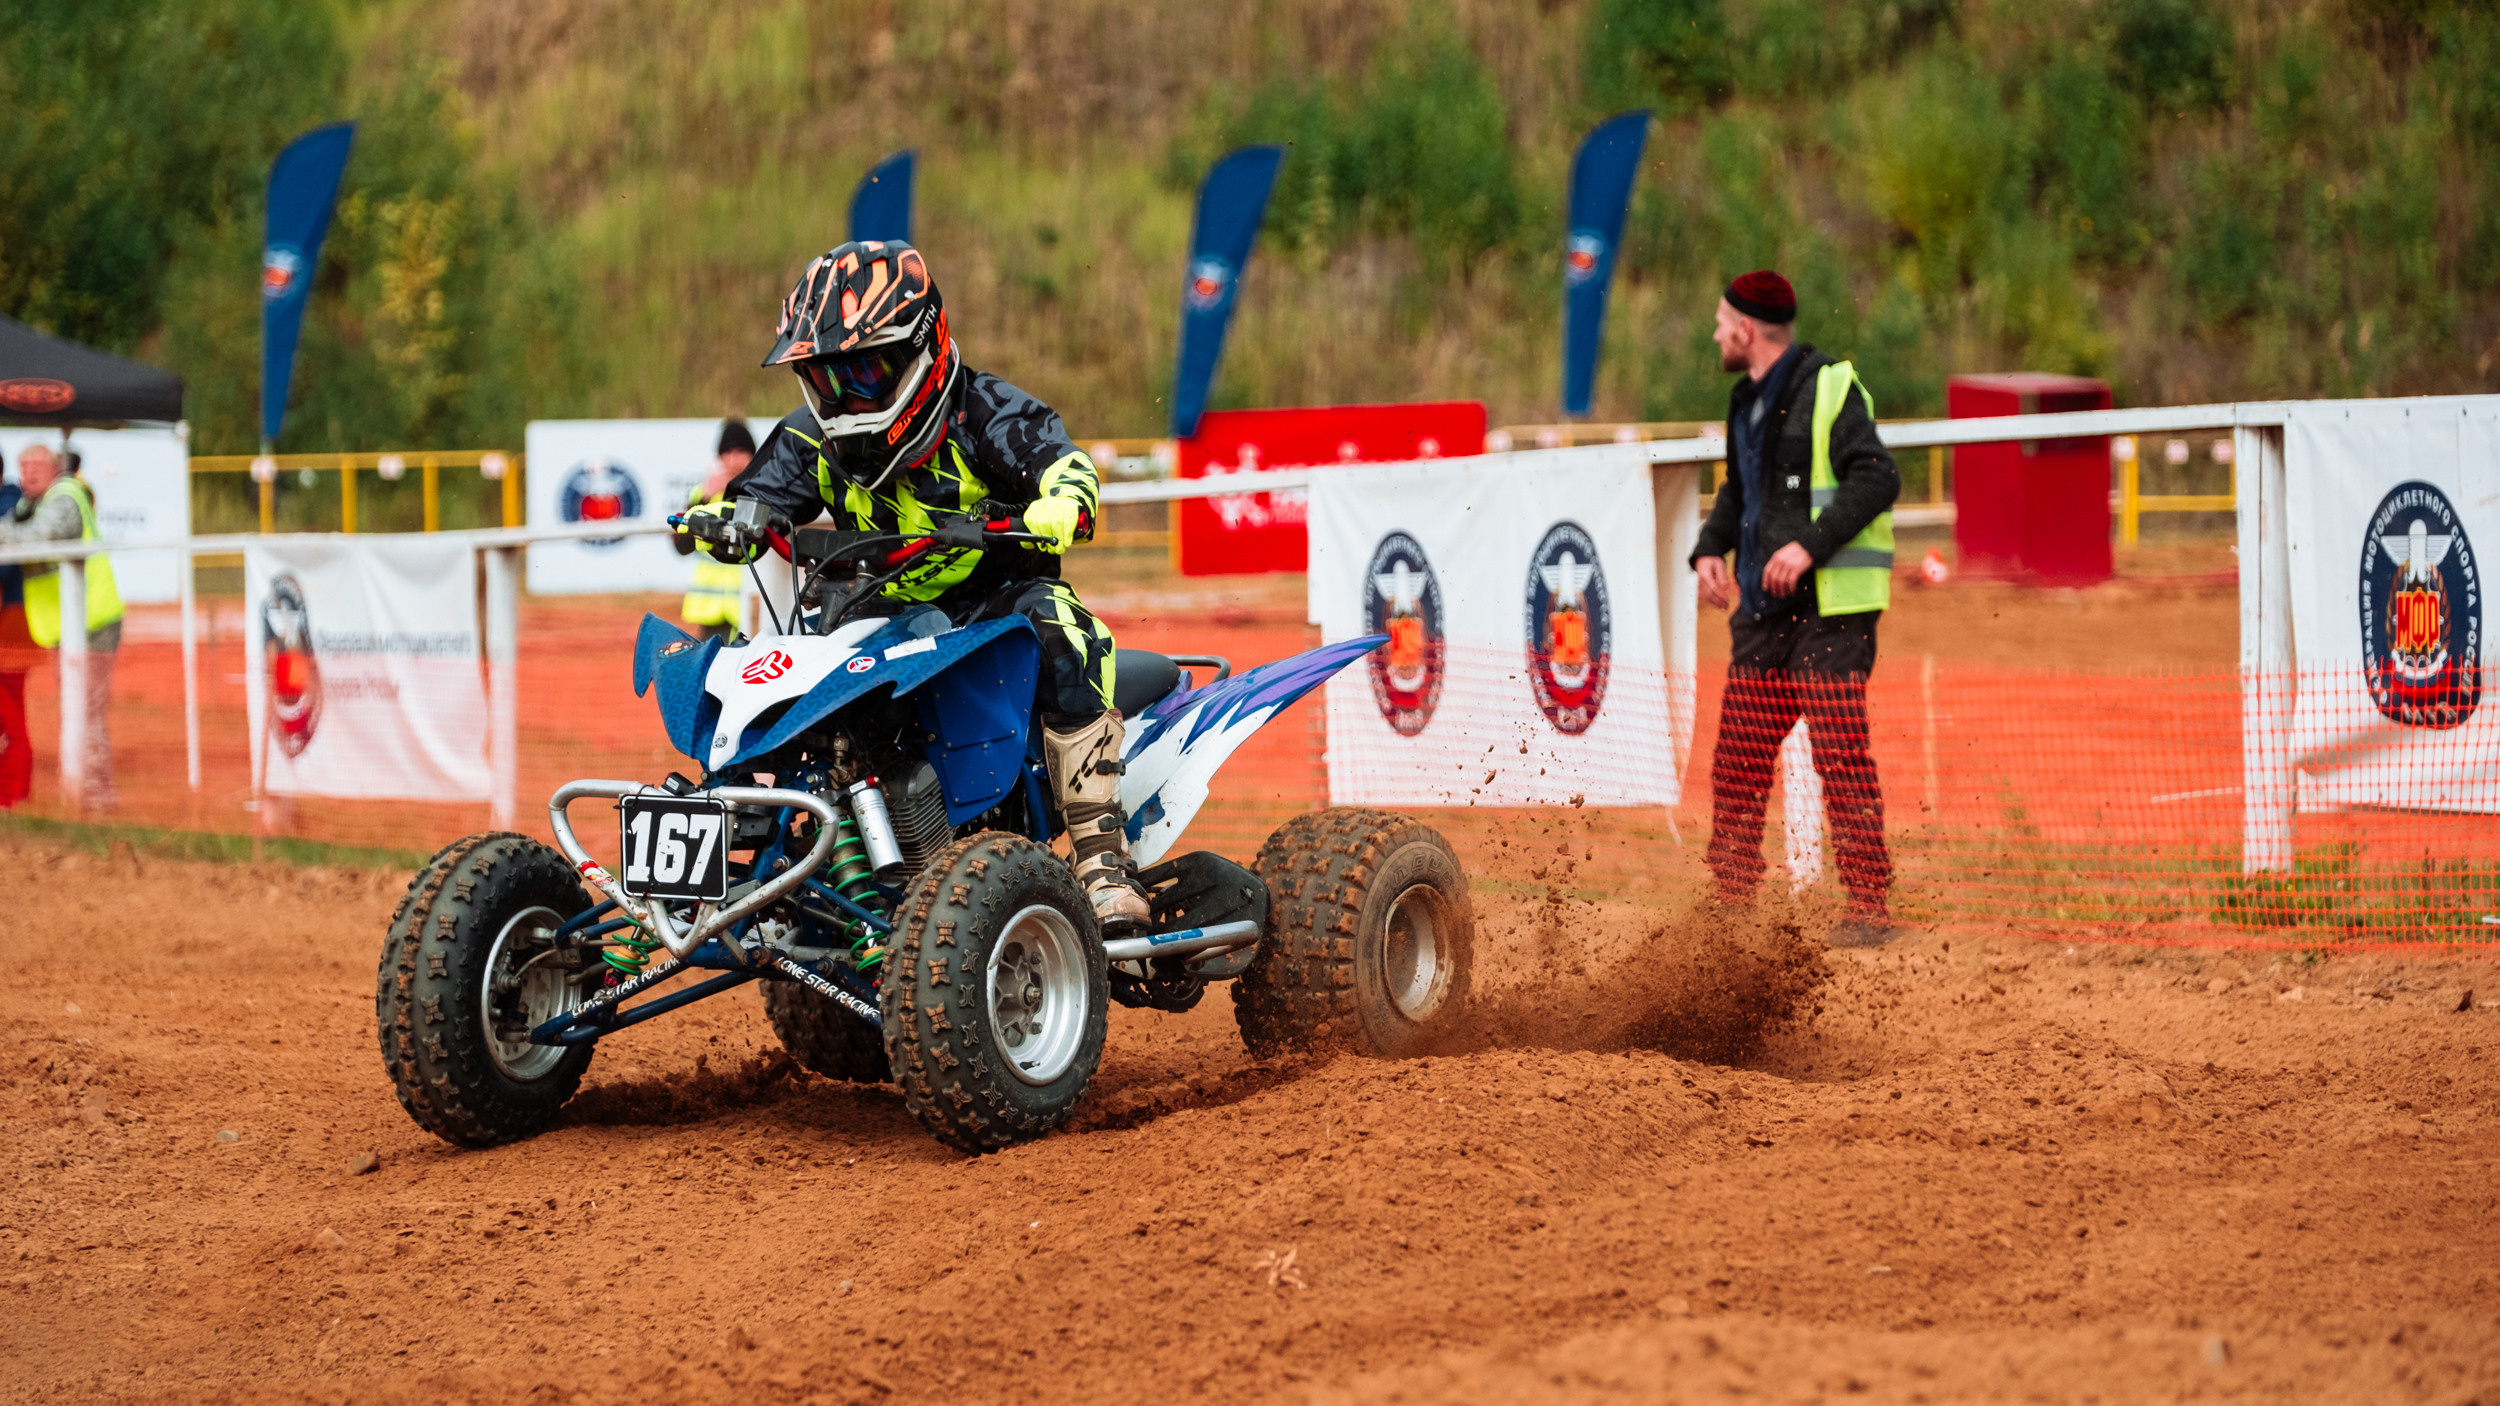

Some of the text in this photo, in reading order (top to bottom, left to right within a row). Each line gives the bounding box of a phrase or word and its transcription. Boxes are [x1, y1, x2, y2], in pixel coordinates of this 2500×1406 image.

[912, 303, 937, 348] SMITH
[2363, 488, 2452, 575] МОТОЦИКЛЕТНОГО
[2450, 524, 2478, 609] СПОРТА
[2395, 588, 2440, 653] МФР
[1068, 722, 1114, 795] TCX
[626, 810, 722, 885] 167
[606, 975, 640, 999] STAR
[776, 956, 881, 1018] LONE STAR RACING
